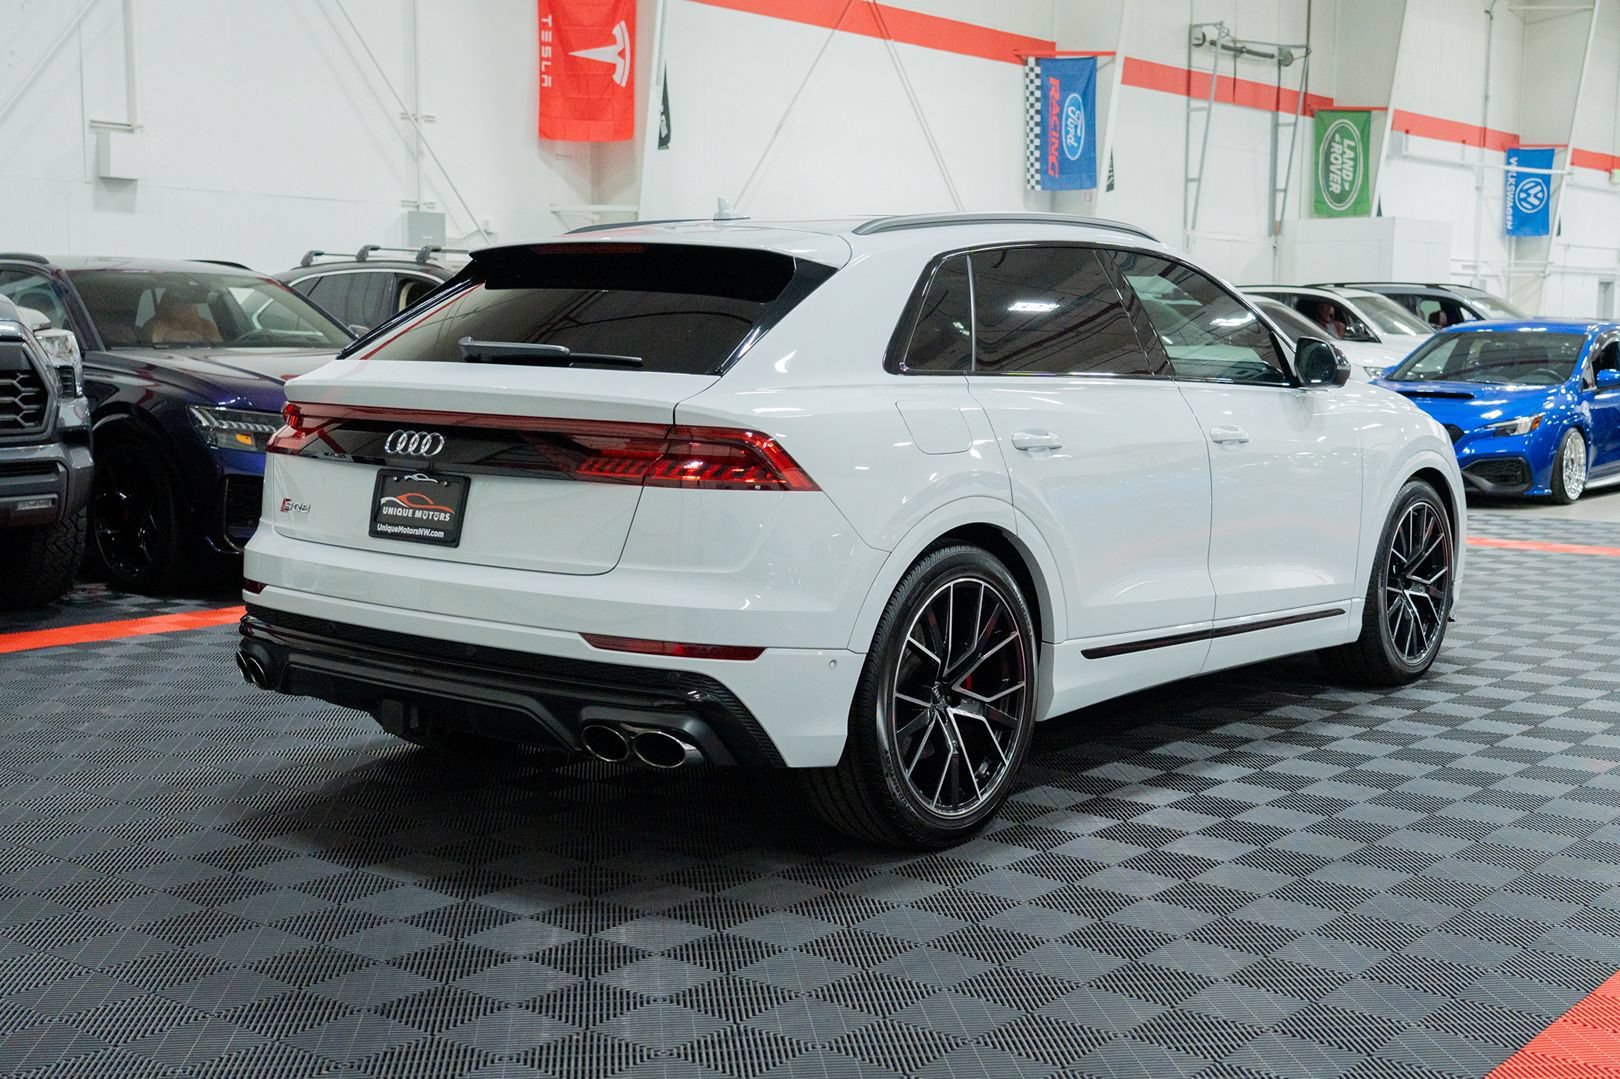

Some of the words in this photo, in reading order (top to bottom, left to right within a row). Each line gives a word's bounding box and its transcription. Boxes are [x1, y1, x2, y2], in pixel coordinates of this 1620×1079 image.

[541, 15, 552, 88] TESLA
[1048, 77, 1060, 178] RACING
[1066, 106, 1081, 148] Ford
[1329, 142, 1343, 194] ROVER
[1343, 138, 1356, 182] LAND
[1506, 157, 1518, 230] VLKSWAGEN
[377, 523, 445, 538] UniqueMotorsNW.com
[382, 506, 413, 518] UNIQUE
[414, 510, 451, 522] MOTORS
